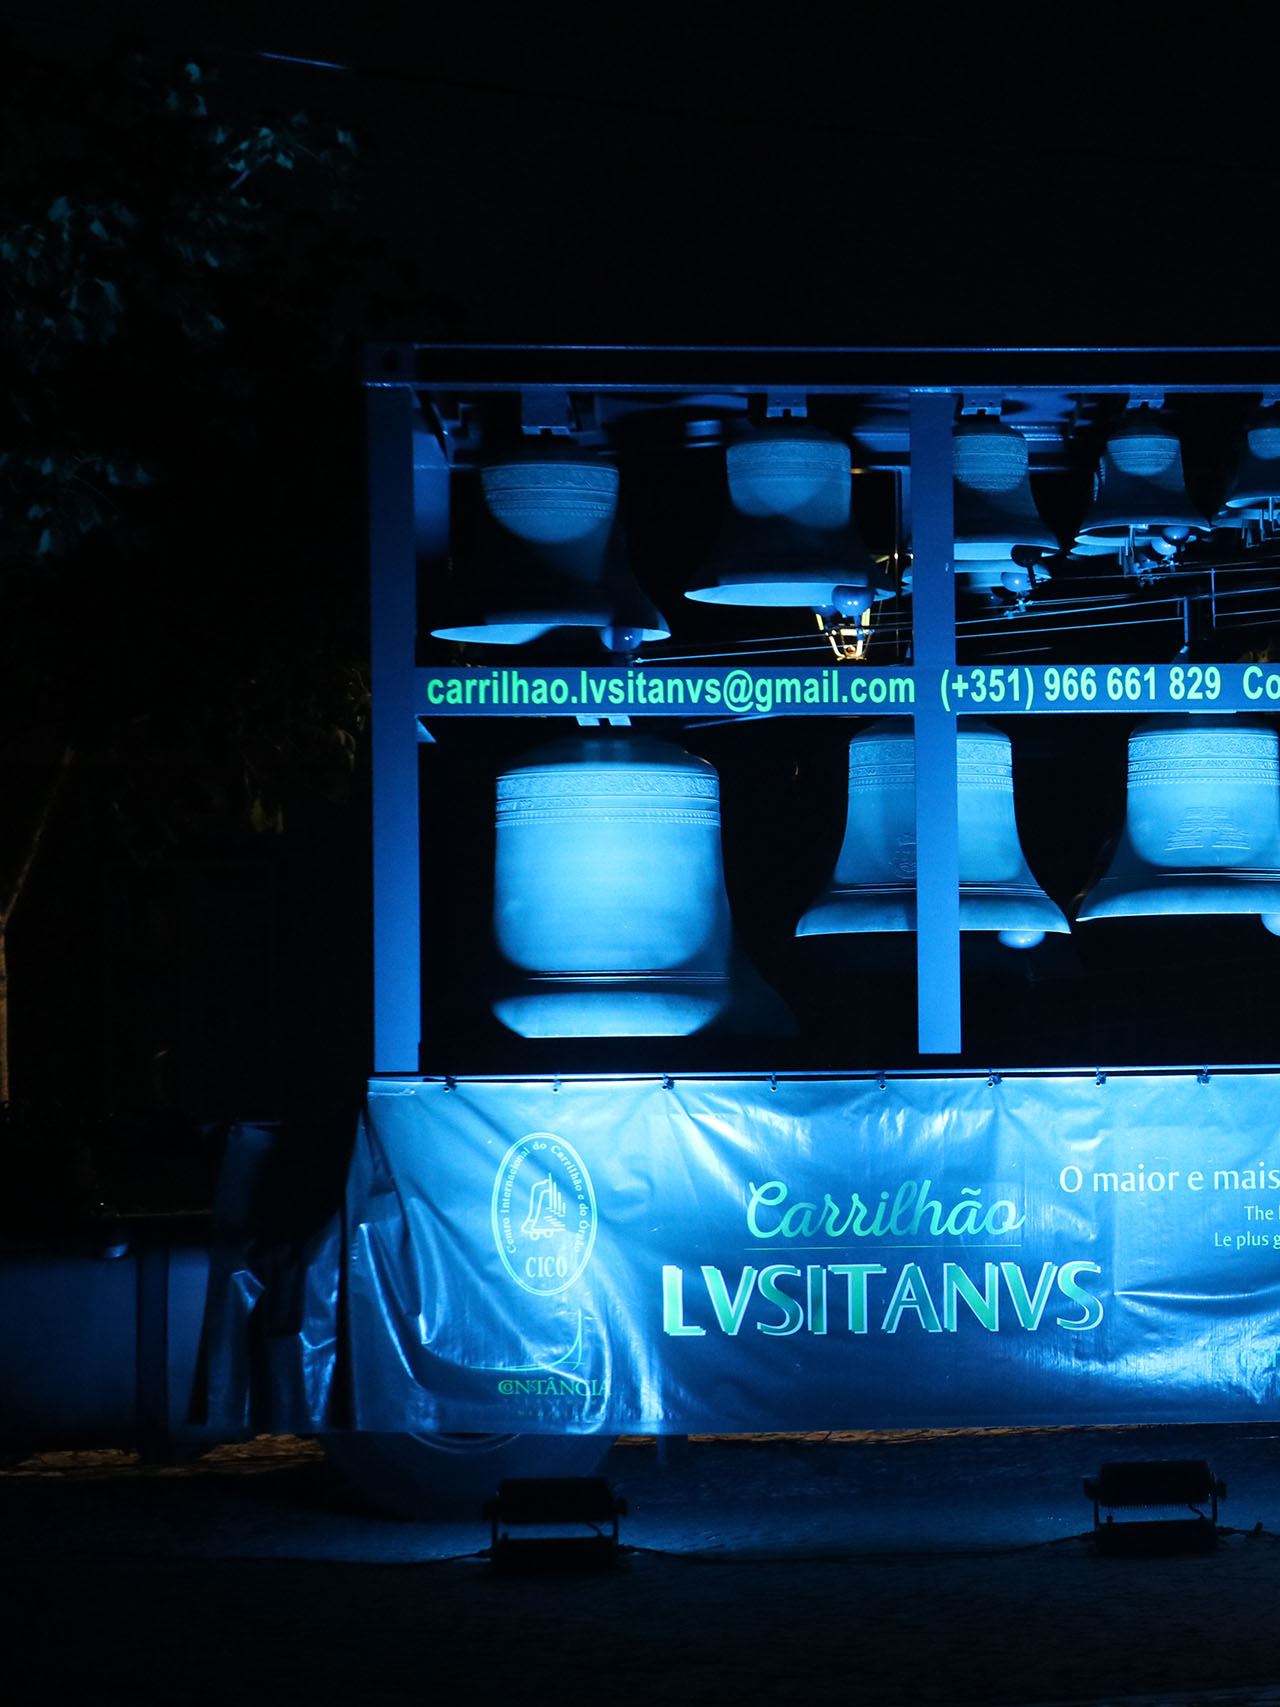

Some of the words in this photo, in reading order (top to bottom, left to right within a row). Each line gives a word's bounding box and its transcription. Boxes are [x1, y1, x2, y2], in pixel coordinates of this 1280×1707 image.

[427, 668, 915, 712] carrilhao.lvsitanvs@gmail.com
[940, 667, 1034, 710] (+351)
[1044, 667, 1098, 701] 966
[1107, 667, 1157, 701] 661
[1169, 665, 1222, 701] 829
[532, 1141, 547, 1151] do
[578, 1203, 589, 1216] do
[1059, 1165, 1083, 1193] O
[1093, 1163, 1180, 1193] maior
[1188, 1171, 1204, 1191] e
[1214, 1161, 1280, 1190] mais
[745, 1179, 1027, 1239] Carrilhão
[1244, 1205, 1275, 1222] The
[1214, 1231, 1232, 1248] Le
[1236, 1230, 1269, 1251] plus
[525, 1256, 568, 1278] CICO
[662, 1260, 1105, 1337] LVSITANVS
